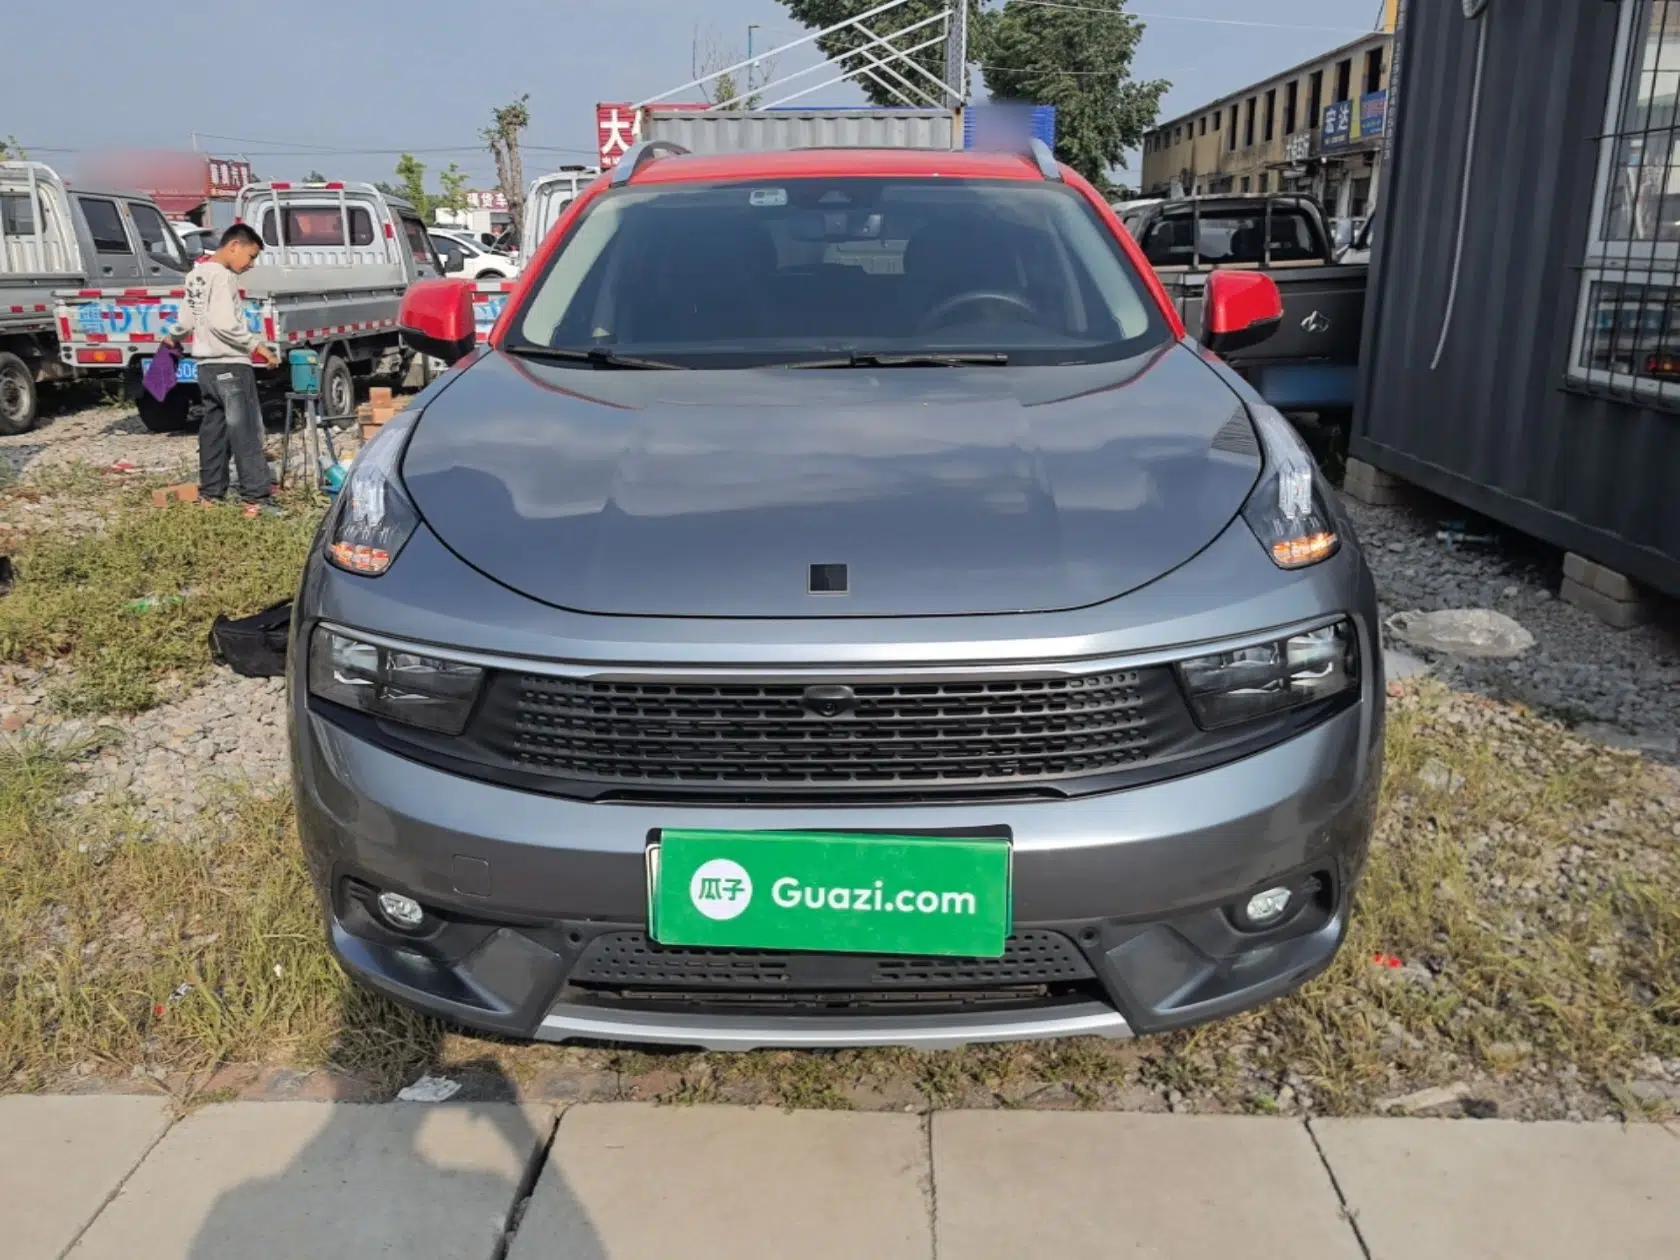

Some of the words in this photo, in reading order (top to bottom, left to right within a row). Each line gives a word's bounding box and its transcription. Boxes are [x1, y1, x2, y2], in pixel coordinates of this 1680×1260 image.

[600, 109, 641, 154] 大
[698, 878, 745, 901] 瓜子
[772, 877, 976, 914] Guazi.com
